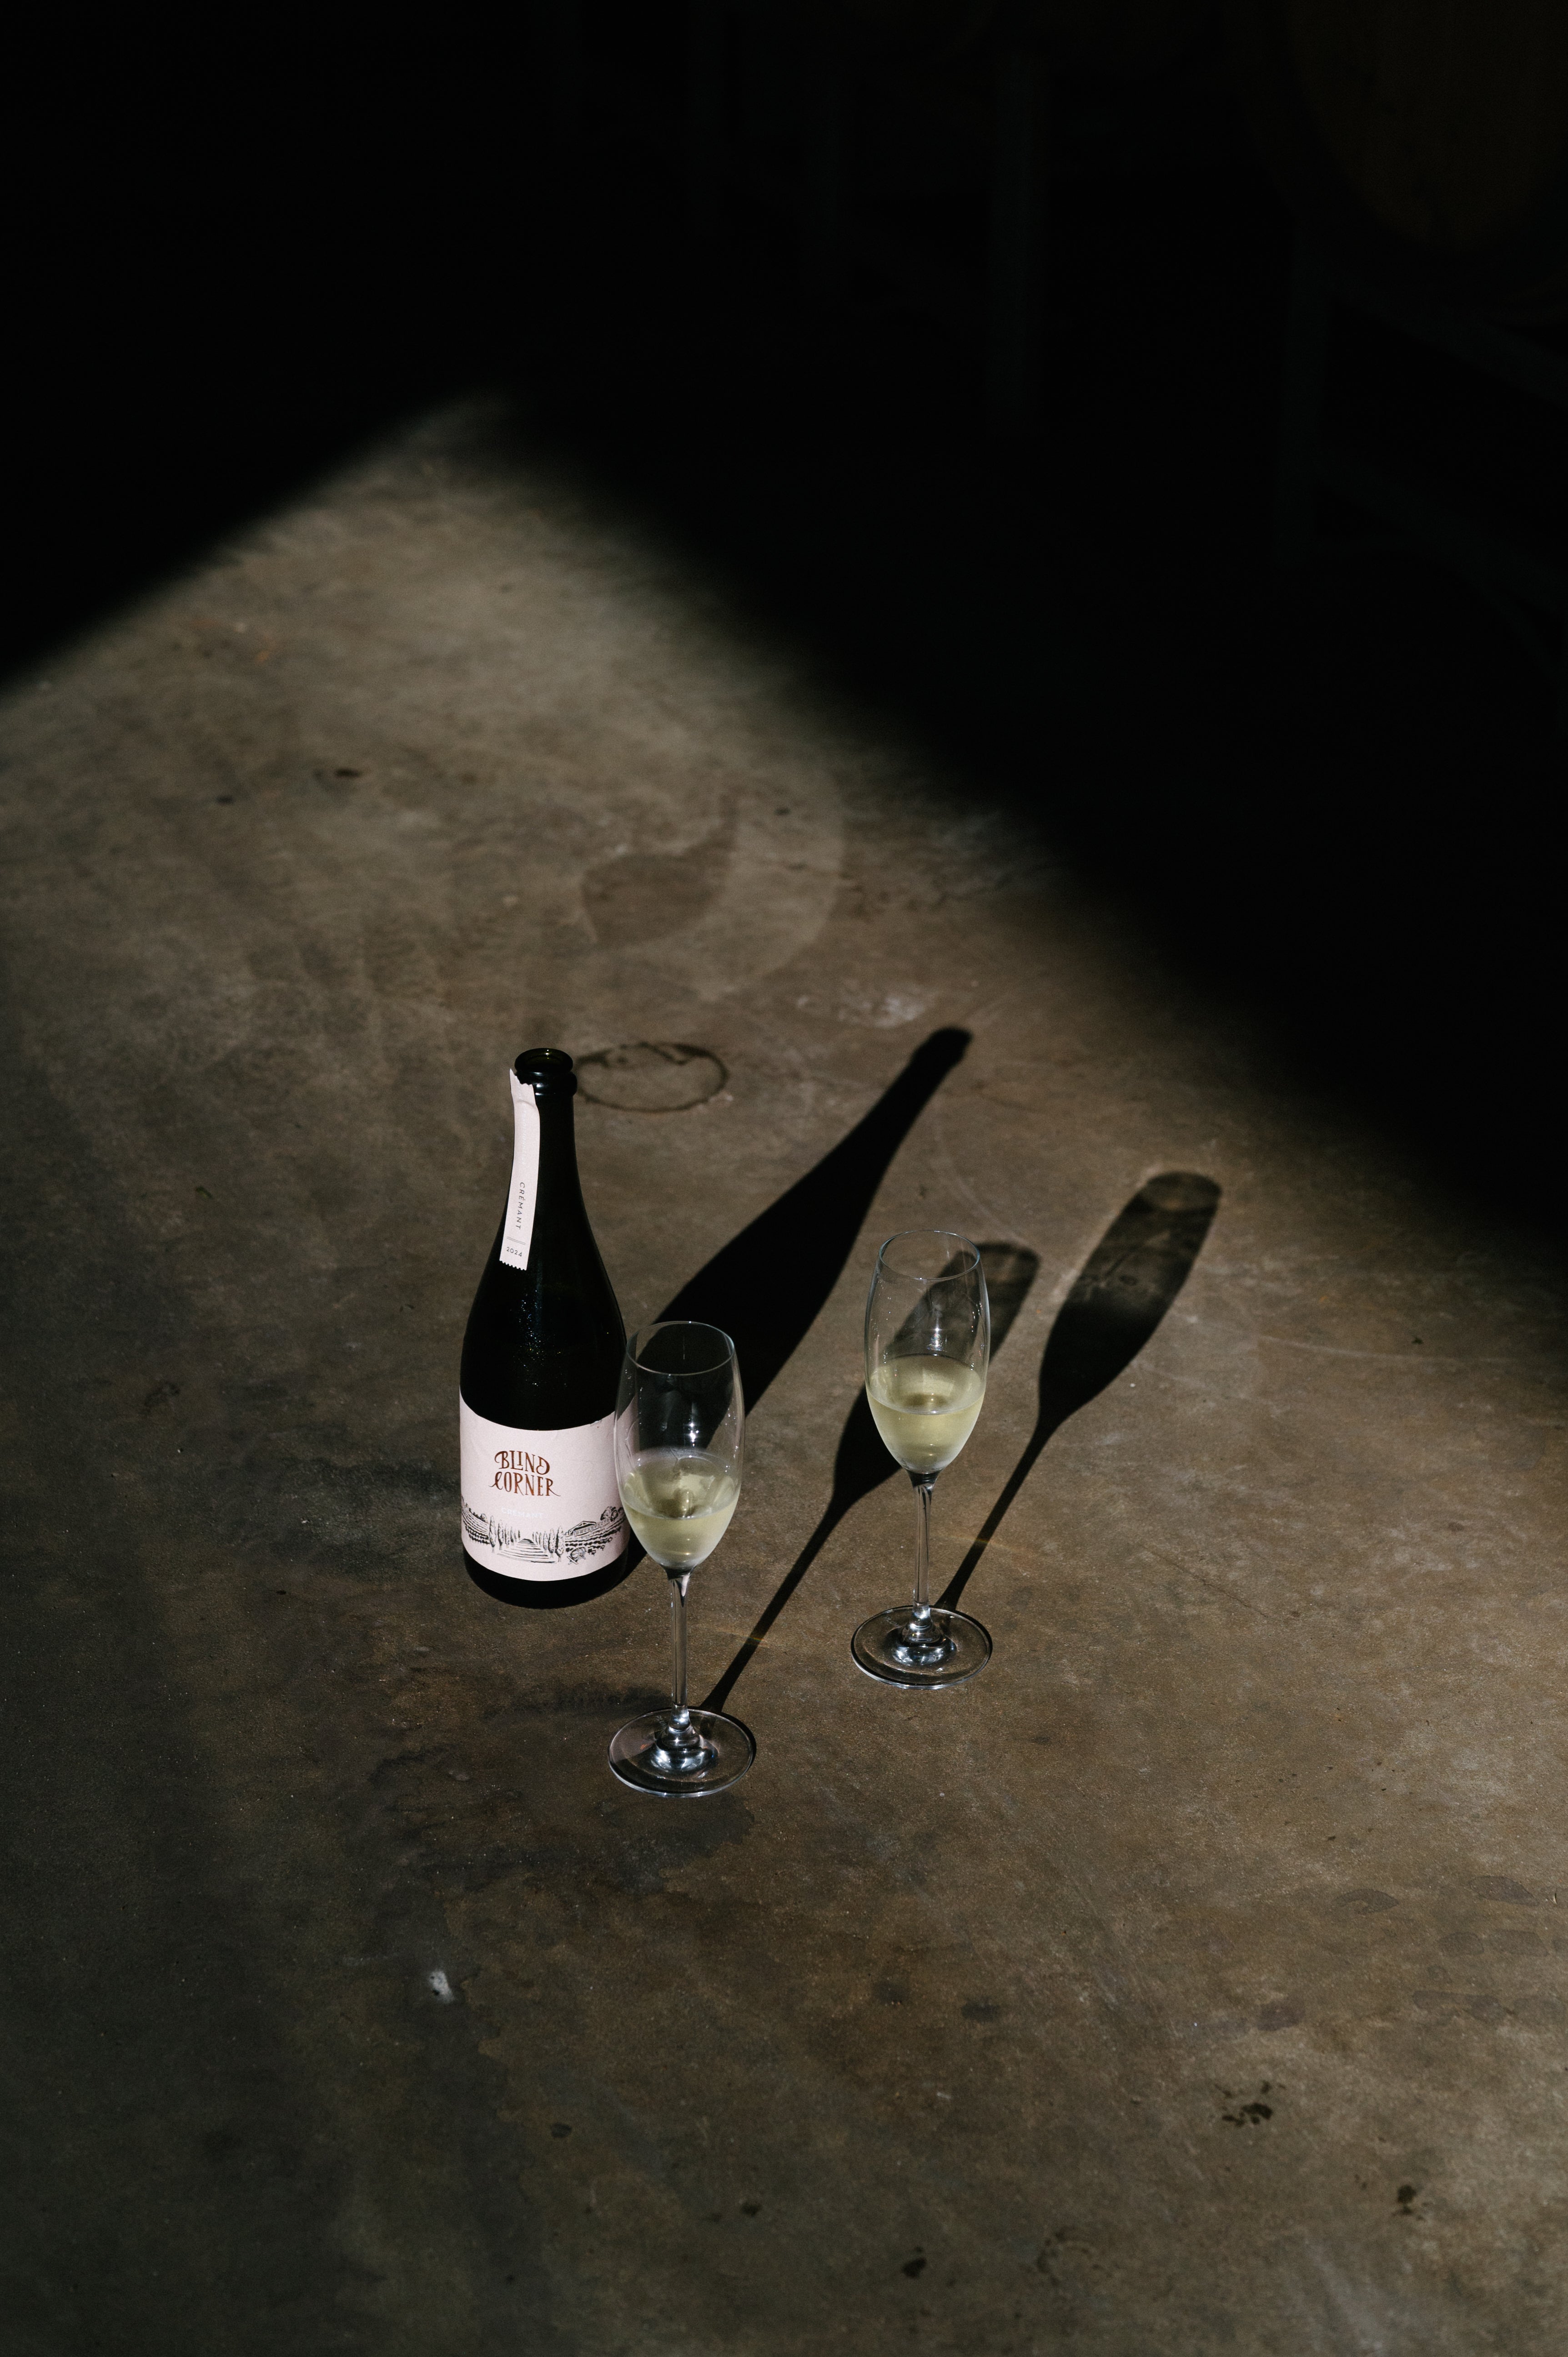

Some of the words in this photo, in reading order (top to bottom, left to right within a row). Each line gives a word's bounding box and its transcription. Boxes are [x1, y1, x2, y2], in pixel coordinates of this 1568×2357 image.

[515, 1182, 526, 1230] CRÉMANT
[506, 1246, 523, 1257] 2024
[494, 1450, 550, 1475] BLIND
[488, 1471, 561, 1497] CORNER
